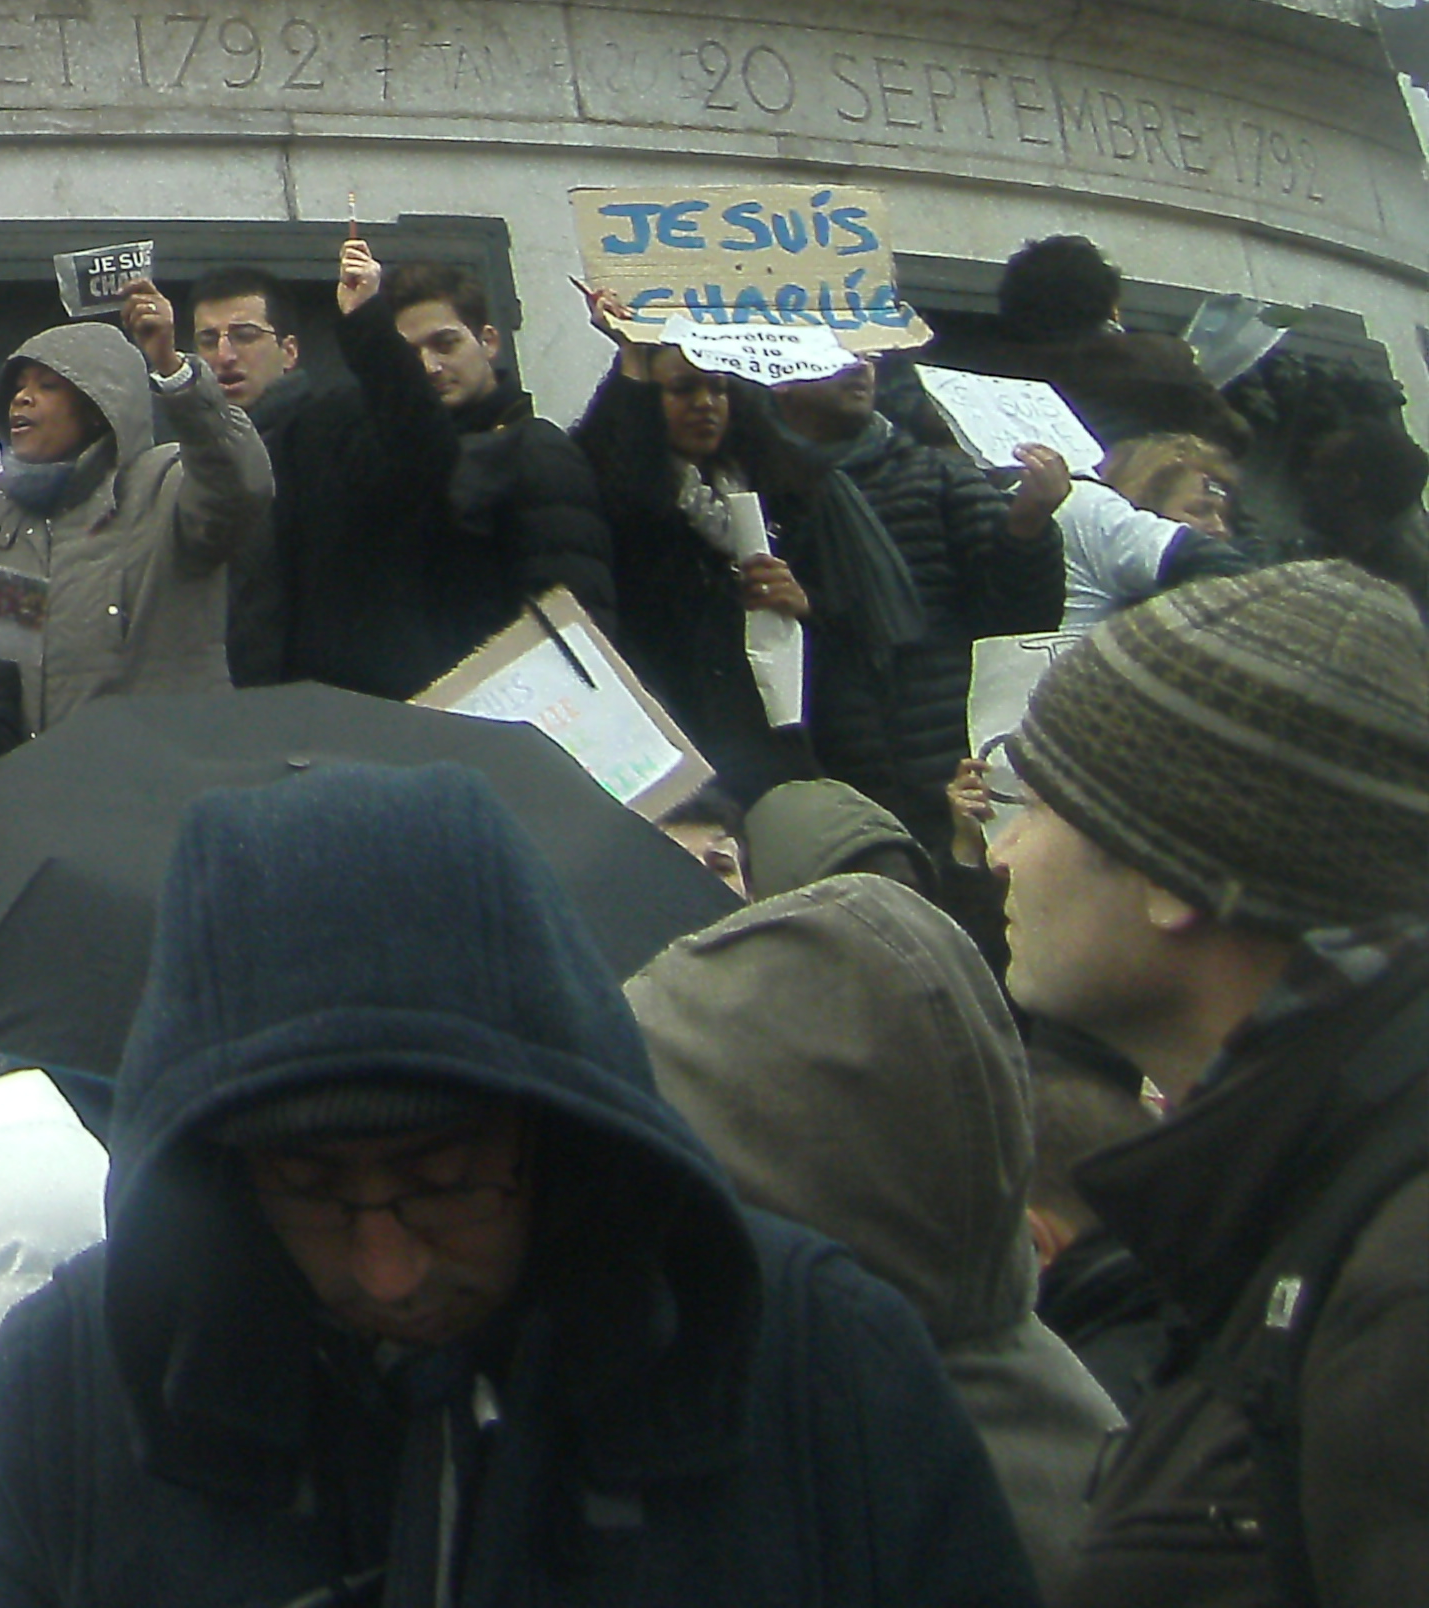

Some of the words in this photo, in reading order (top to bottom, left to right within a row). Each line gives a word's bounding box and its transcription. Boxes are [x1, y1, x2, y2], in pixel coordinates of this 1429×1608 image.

[133, 13, 326, 90] 1792
[697, 37, 796, 115] 20
[831, 52, 1212, 177] SEPTEMBRE
[598, 199, 710, 255] JE
[88, 256, 117, 275] JE
